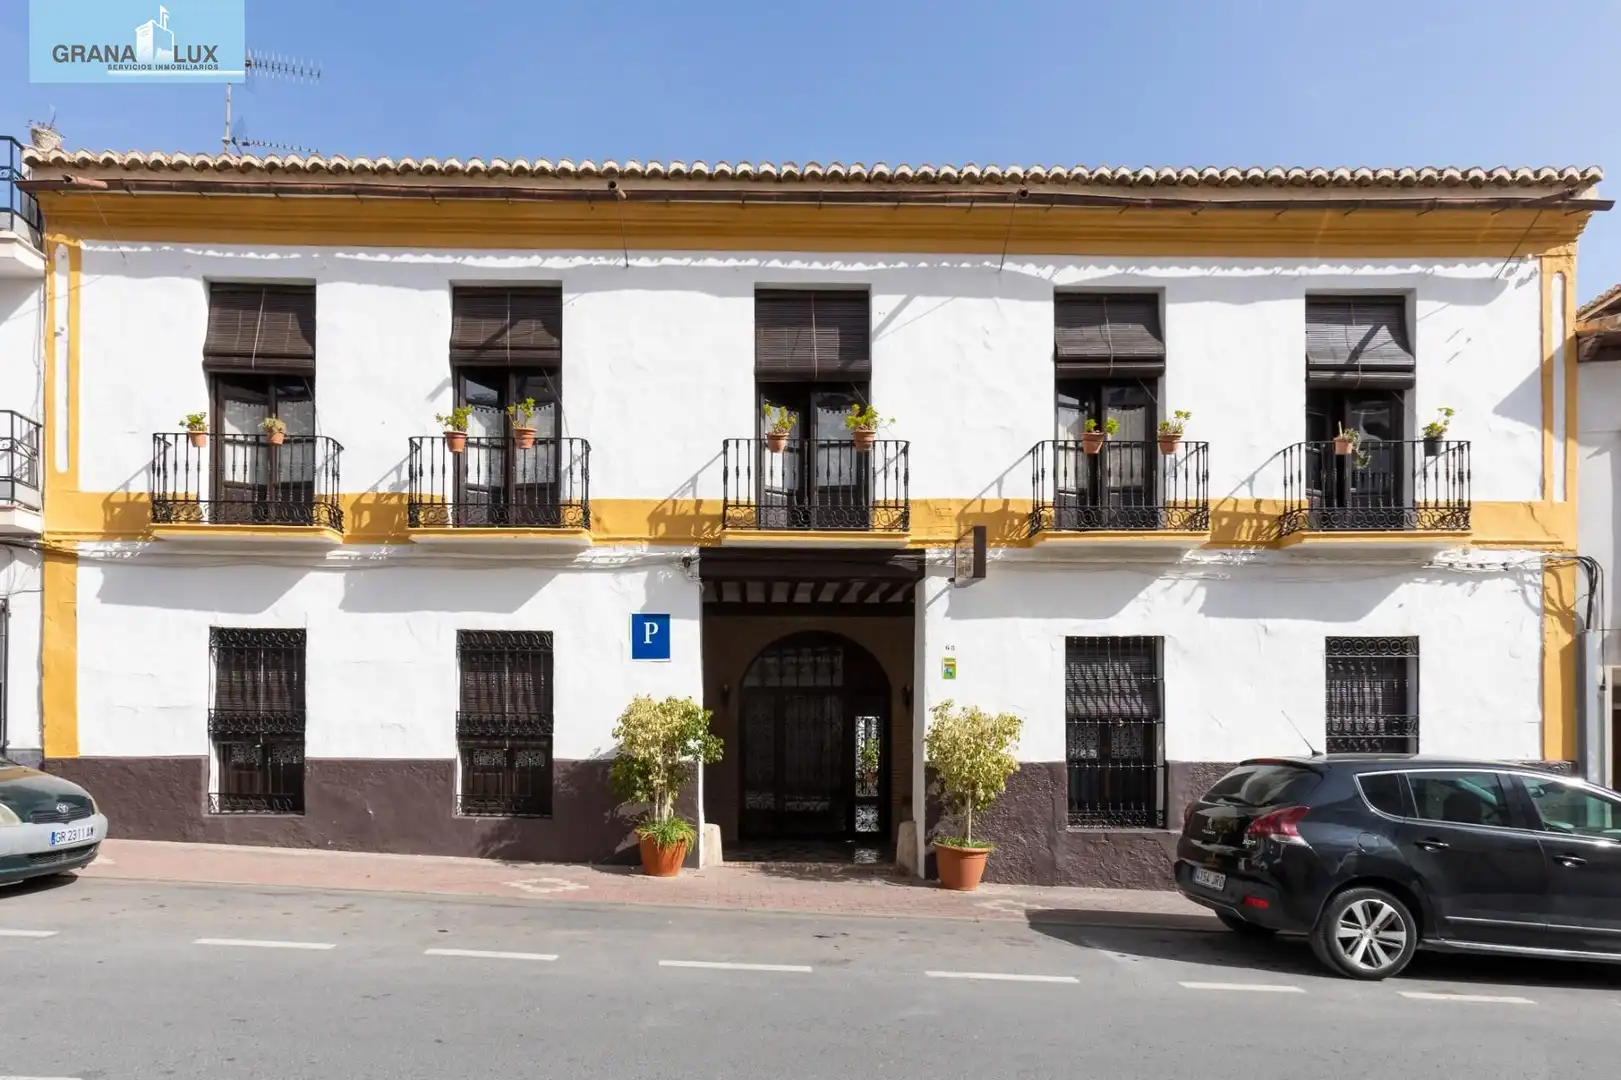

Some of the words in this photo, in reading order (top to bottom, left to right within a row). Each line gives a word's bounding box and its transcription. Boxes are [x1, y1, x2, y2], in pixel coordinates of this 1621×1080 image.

[643, 621, 659, 644] P
[56, 831, 66, 843] GR
[68, 828, 85, 841] 2311
